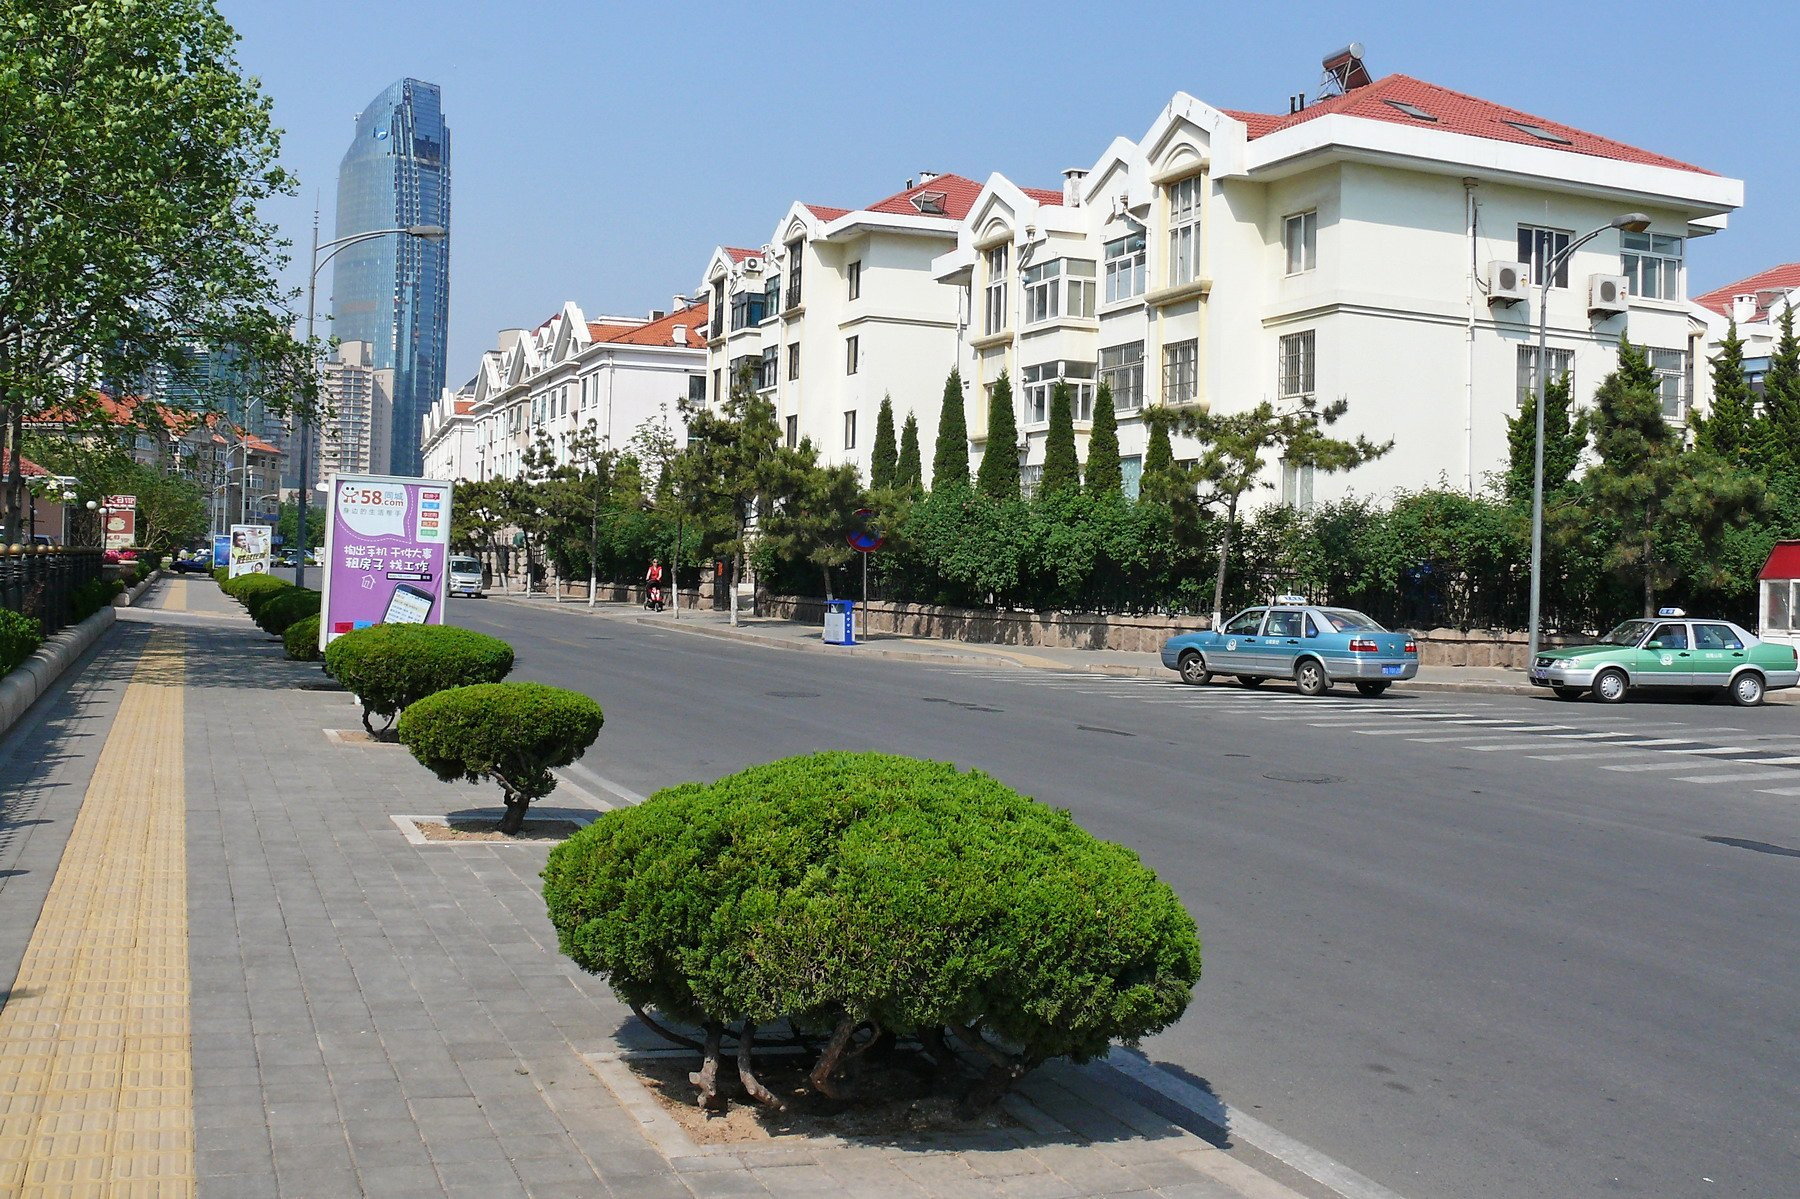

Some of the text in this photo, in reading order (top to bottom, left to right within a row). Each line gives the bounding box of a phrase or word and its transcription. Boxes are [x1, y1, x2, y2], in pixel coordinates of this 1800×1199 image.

[361, 489, 382, 505] 58
[381, 499, 404, 507] .com
[384, 491, 404, 500] 同城
[344, 545, 433, 560] 掏出手机 干件大事
[345, 557, 429, 573] 租房子 找工作
